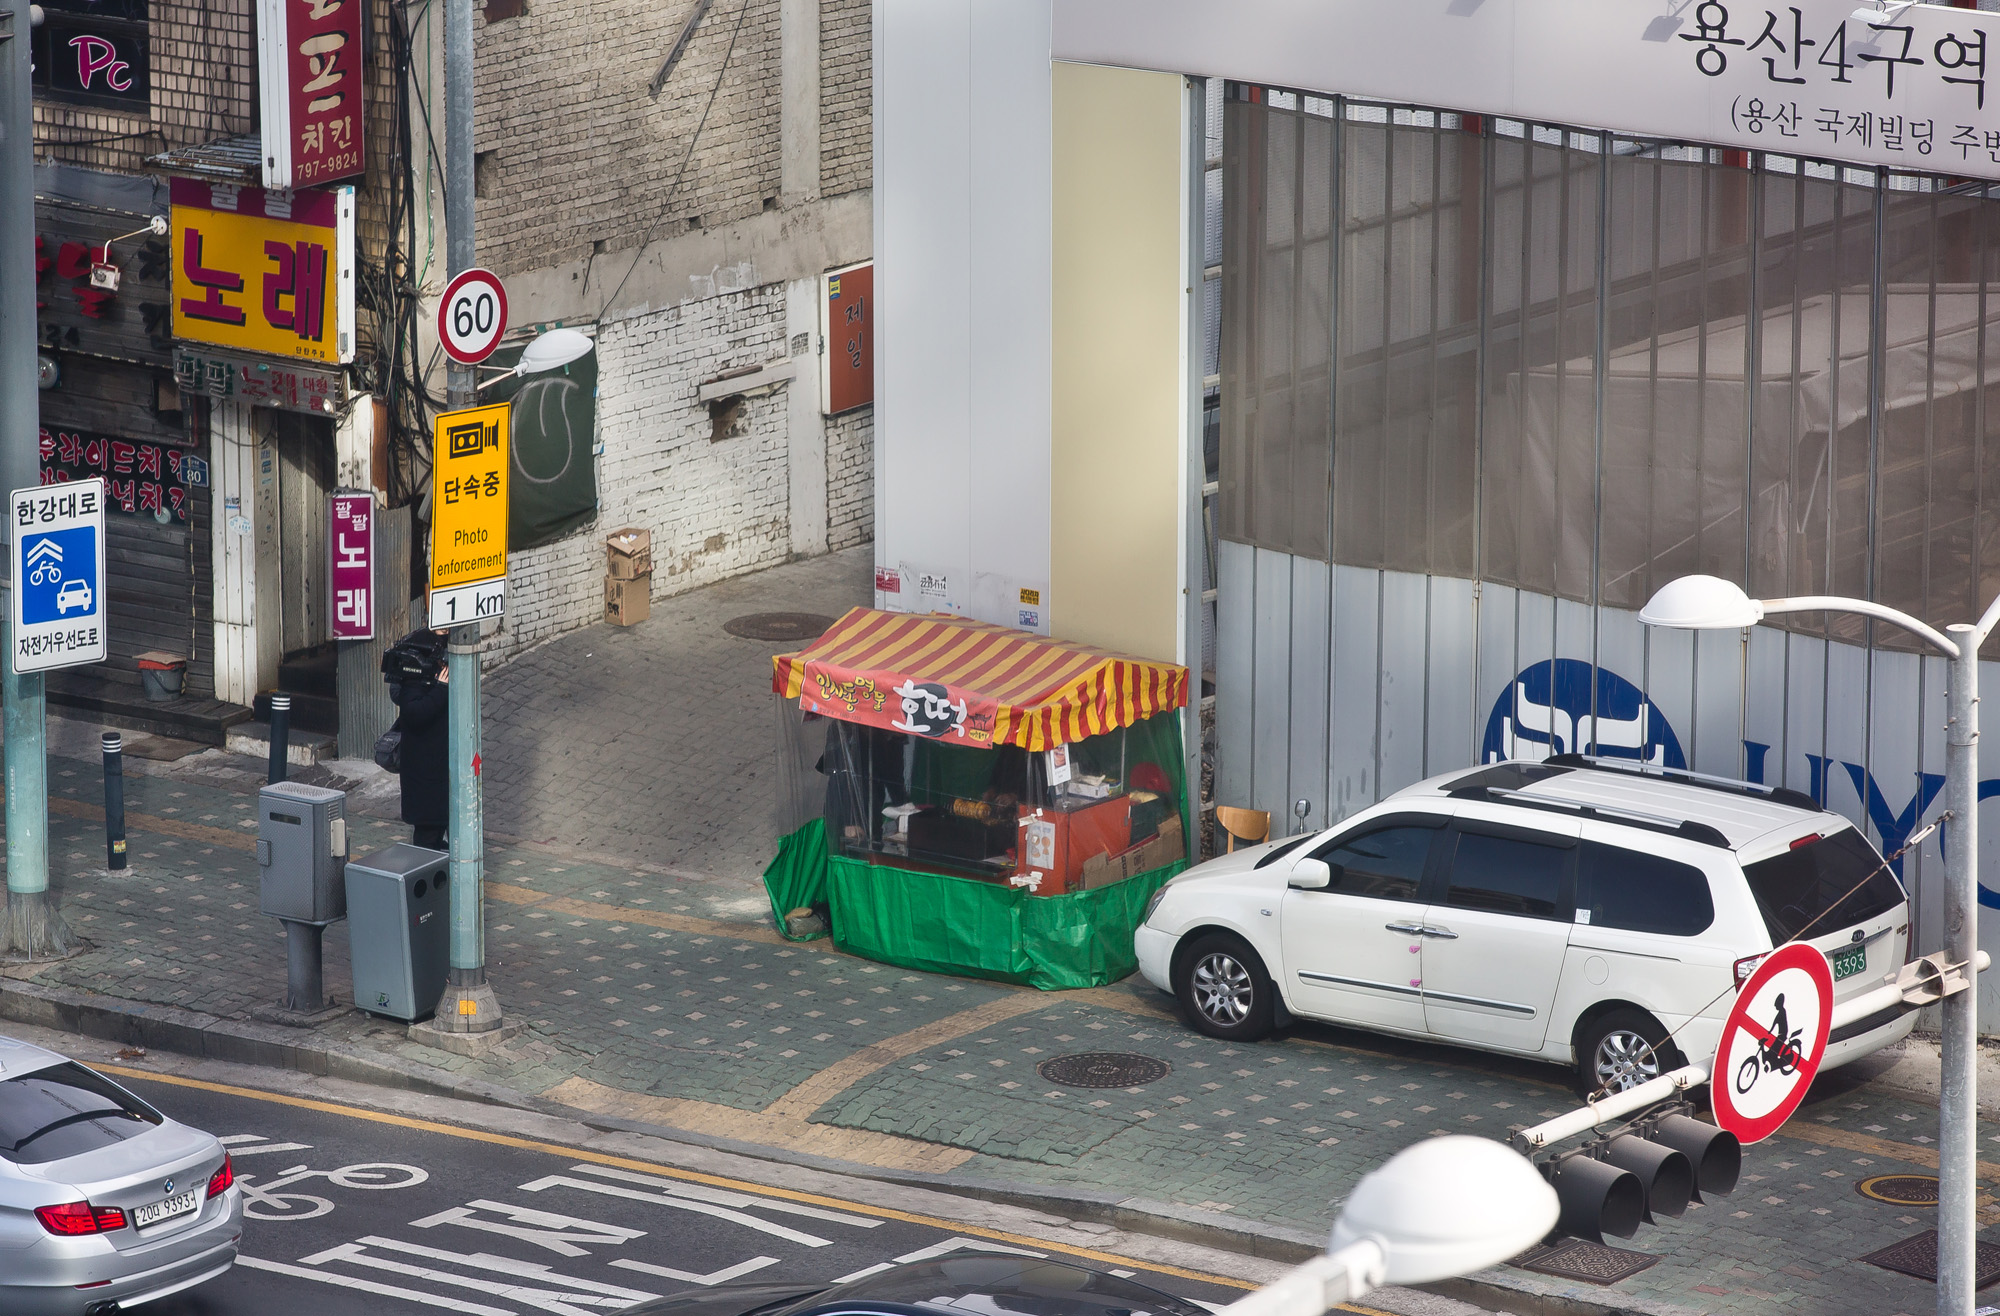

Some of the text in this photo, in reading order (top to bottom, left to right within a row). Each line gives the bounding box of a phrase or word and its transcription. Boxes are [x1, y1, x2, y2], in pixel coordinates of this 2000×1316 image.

[1678, 0, 1987, 110] 용산4구역
[301, 115, 352, 155] 치킨
[1813, 106, 1934, 156] 국제빌딩
[297, 151, 359, 181] 797-9824
[180, 227, 327, 341] 노래
[453, 292, 494, 338] 60
[844, 295, 864, 368] 제일
[241, 365, 298, 406] 노래
[302, 376, 328, 395] 대형
[186, 468, 201, 483] 80
[444, 470, 500, 505] 단속중
[17, 491, 99, 526] 한강대로
[336, 501, 368, 532] 팔팔
[454, 526, 488, 547] Photo
[337, 532, 367, 627] 노래
[437, 551, 503, 577] enforcement
[446, 591, 504, 621] 1 km
[19, 628, 99, 657] 자전거우선도로
[815, 673, 968, 738] 인사동 명물 호떡
[1835, 952, 1866, 978] 3393
[164, 1193, 191, 1214] 9393
